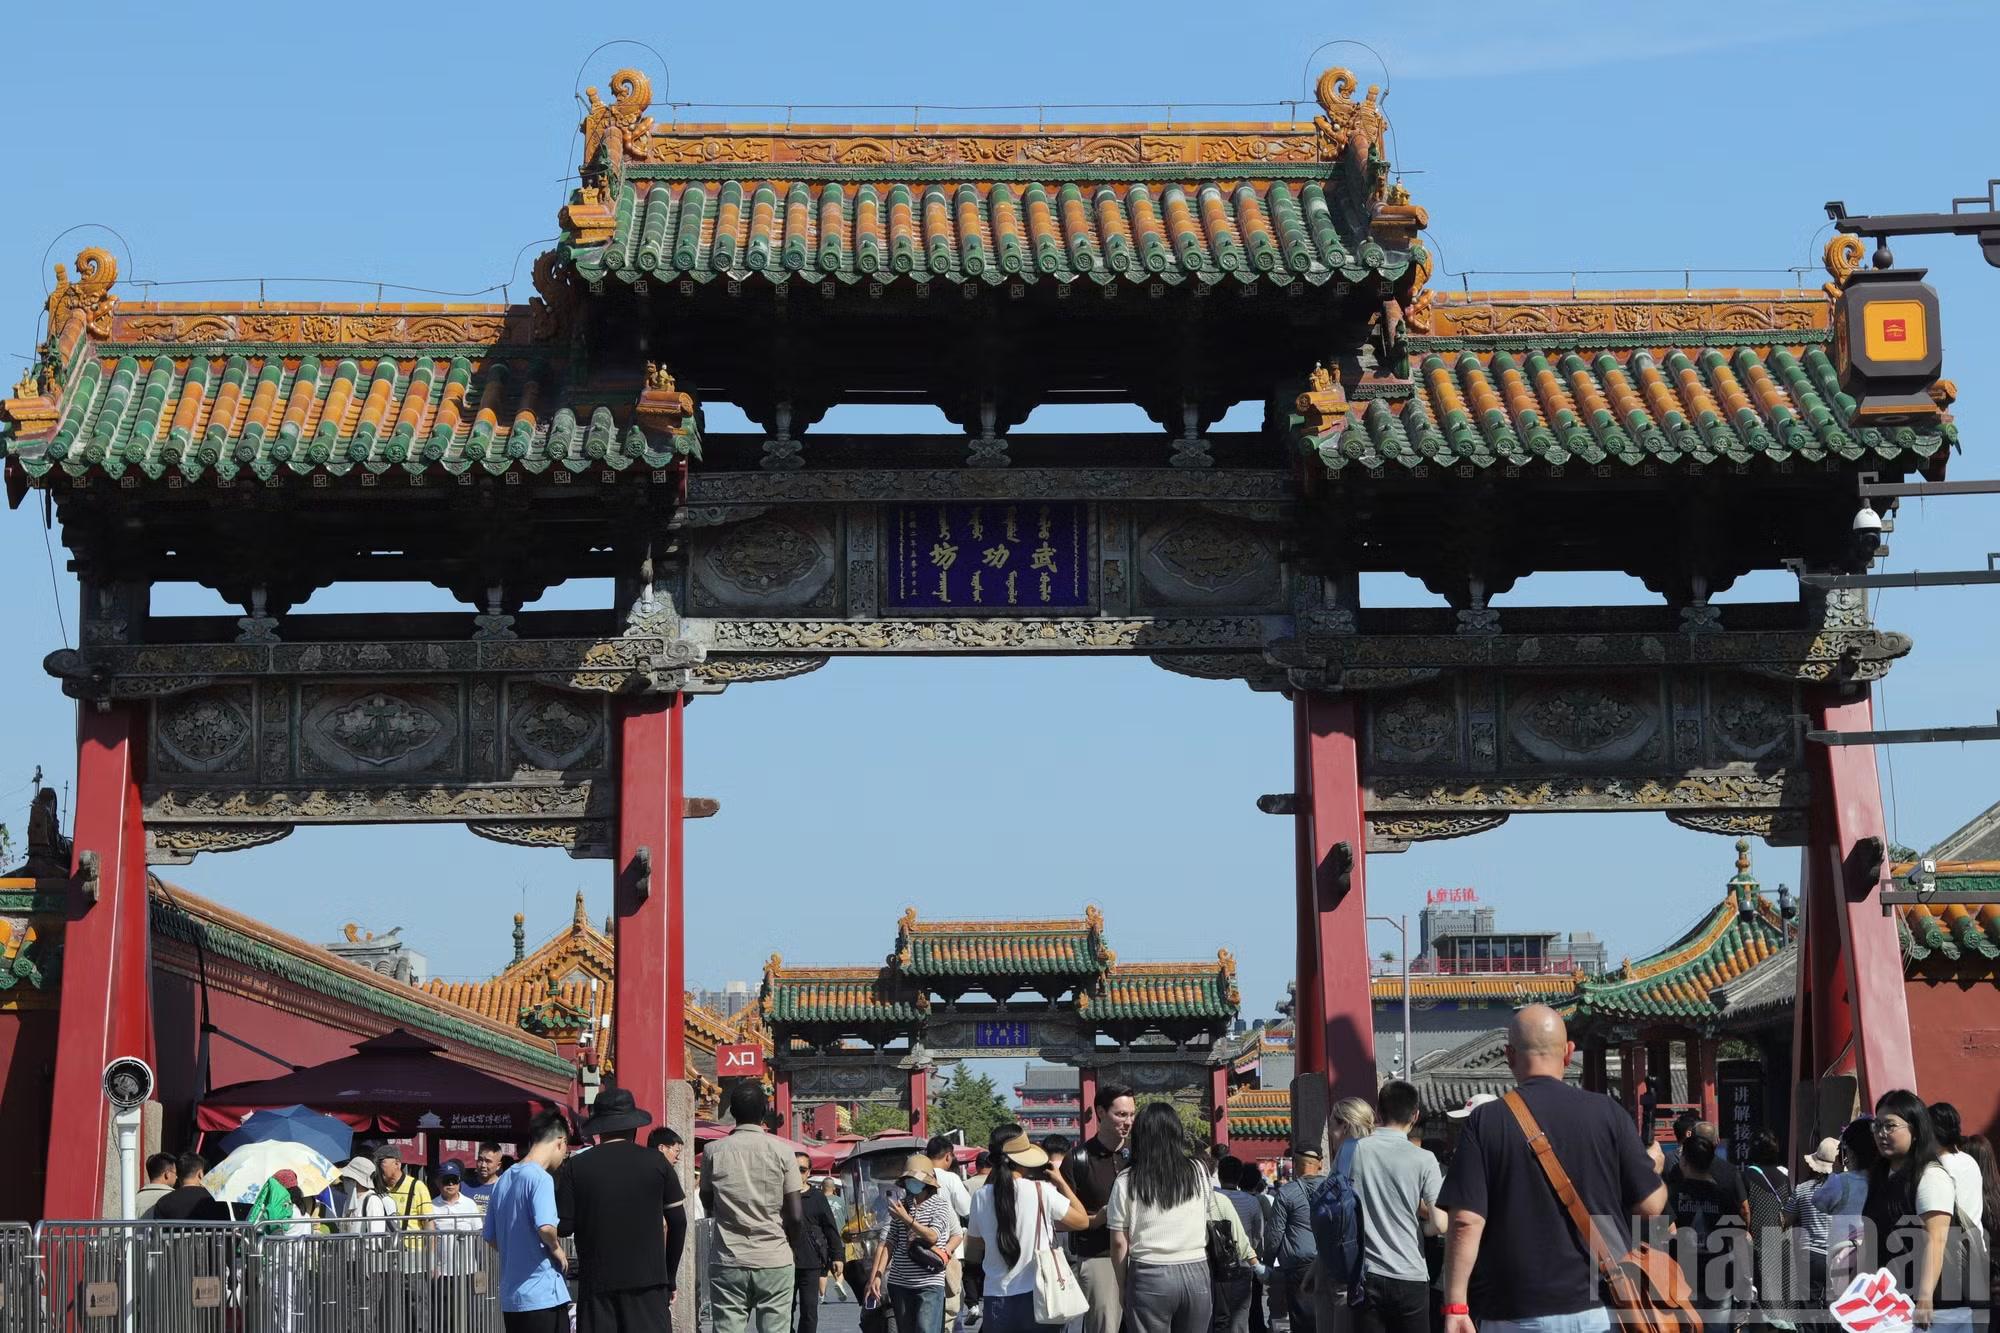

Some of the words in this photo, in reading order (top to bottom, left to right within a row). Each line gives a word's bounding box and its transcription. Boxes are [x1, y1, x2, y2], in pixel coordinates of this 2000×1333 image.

[929, 541, 1058, 574] 武功坊
[1436, 887, 1480, 903] 童话镇
[725, 1051, 755, 1067] 入口
